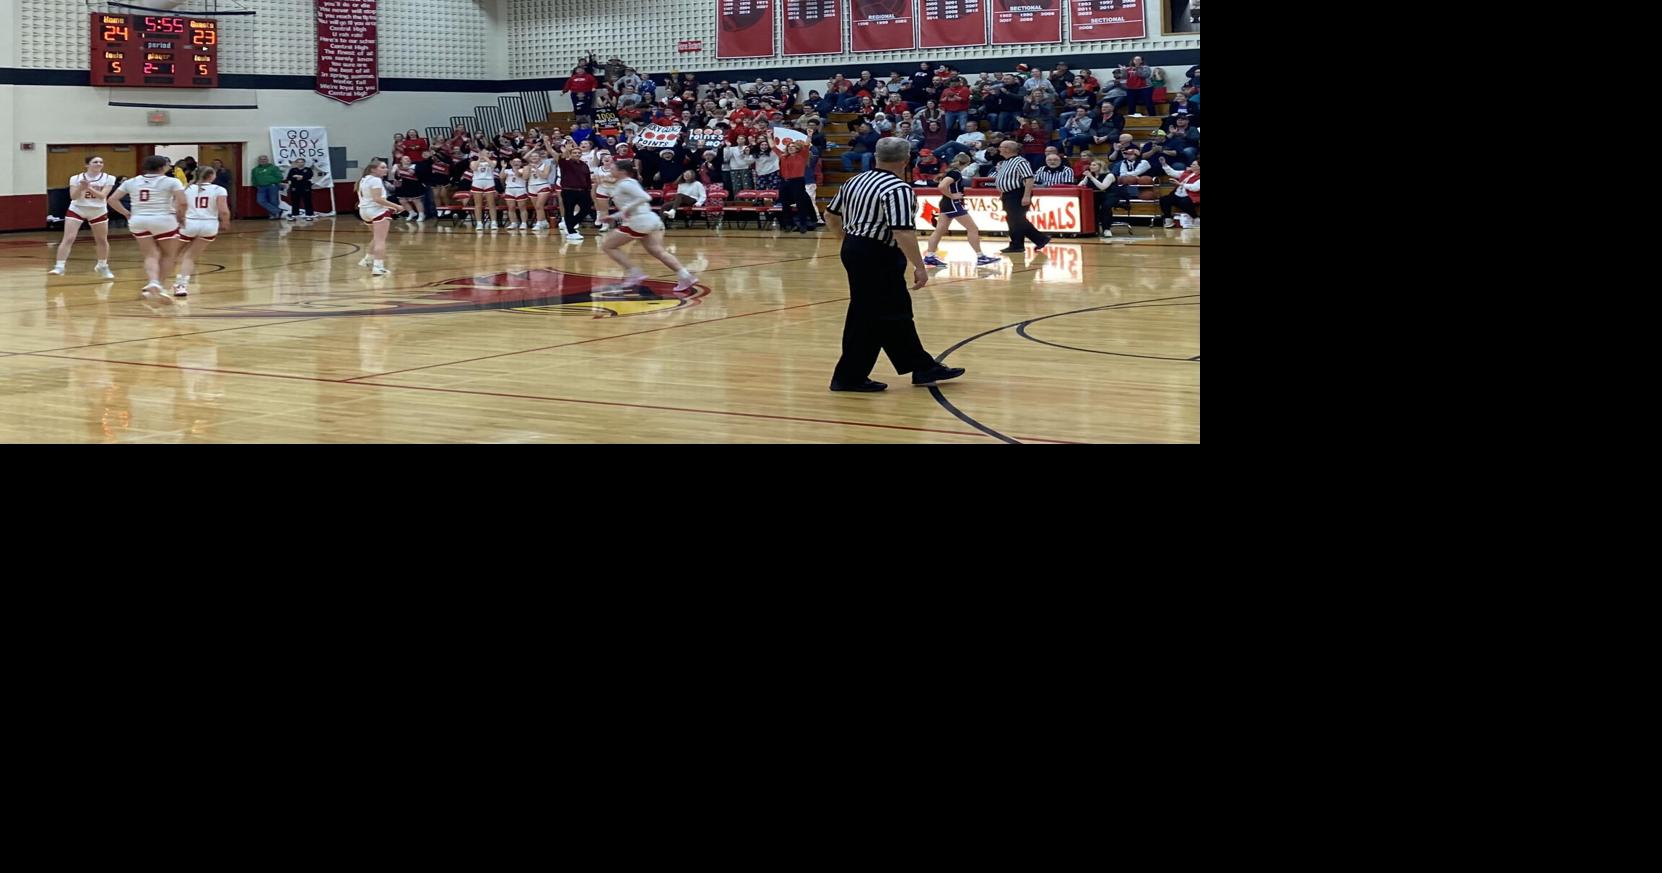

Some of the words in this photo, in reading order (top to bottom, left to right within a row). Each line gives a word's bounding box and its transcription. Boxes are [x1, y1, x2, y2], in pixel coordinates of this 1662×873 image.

[145, 16, 184, 33] 5:55
[104, 25, 128, 41] 24
[193, 30, 215, 45] 23
[112, 61, 121, 73] 5
[199, 64, 208, 75] 5
[287, 129, 310, 140] GO
[278, 138, 320, 149] LADY
[637, 137, 669, 147] POINTS
[279, 148, 325, 159] CARDS
[139, 189, 150, 202] 0
[195, 196, 209, 209] 10
